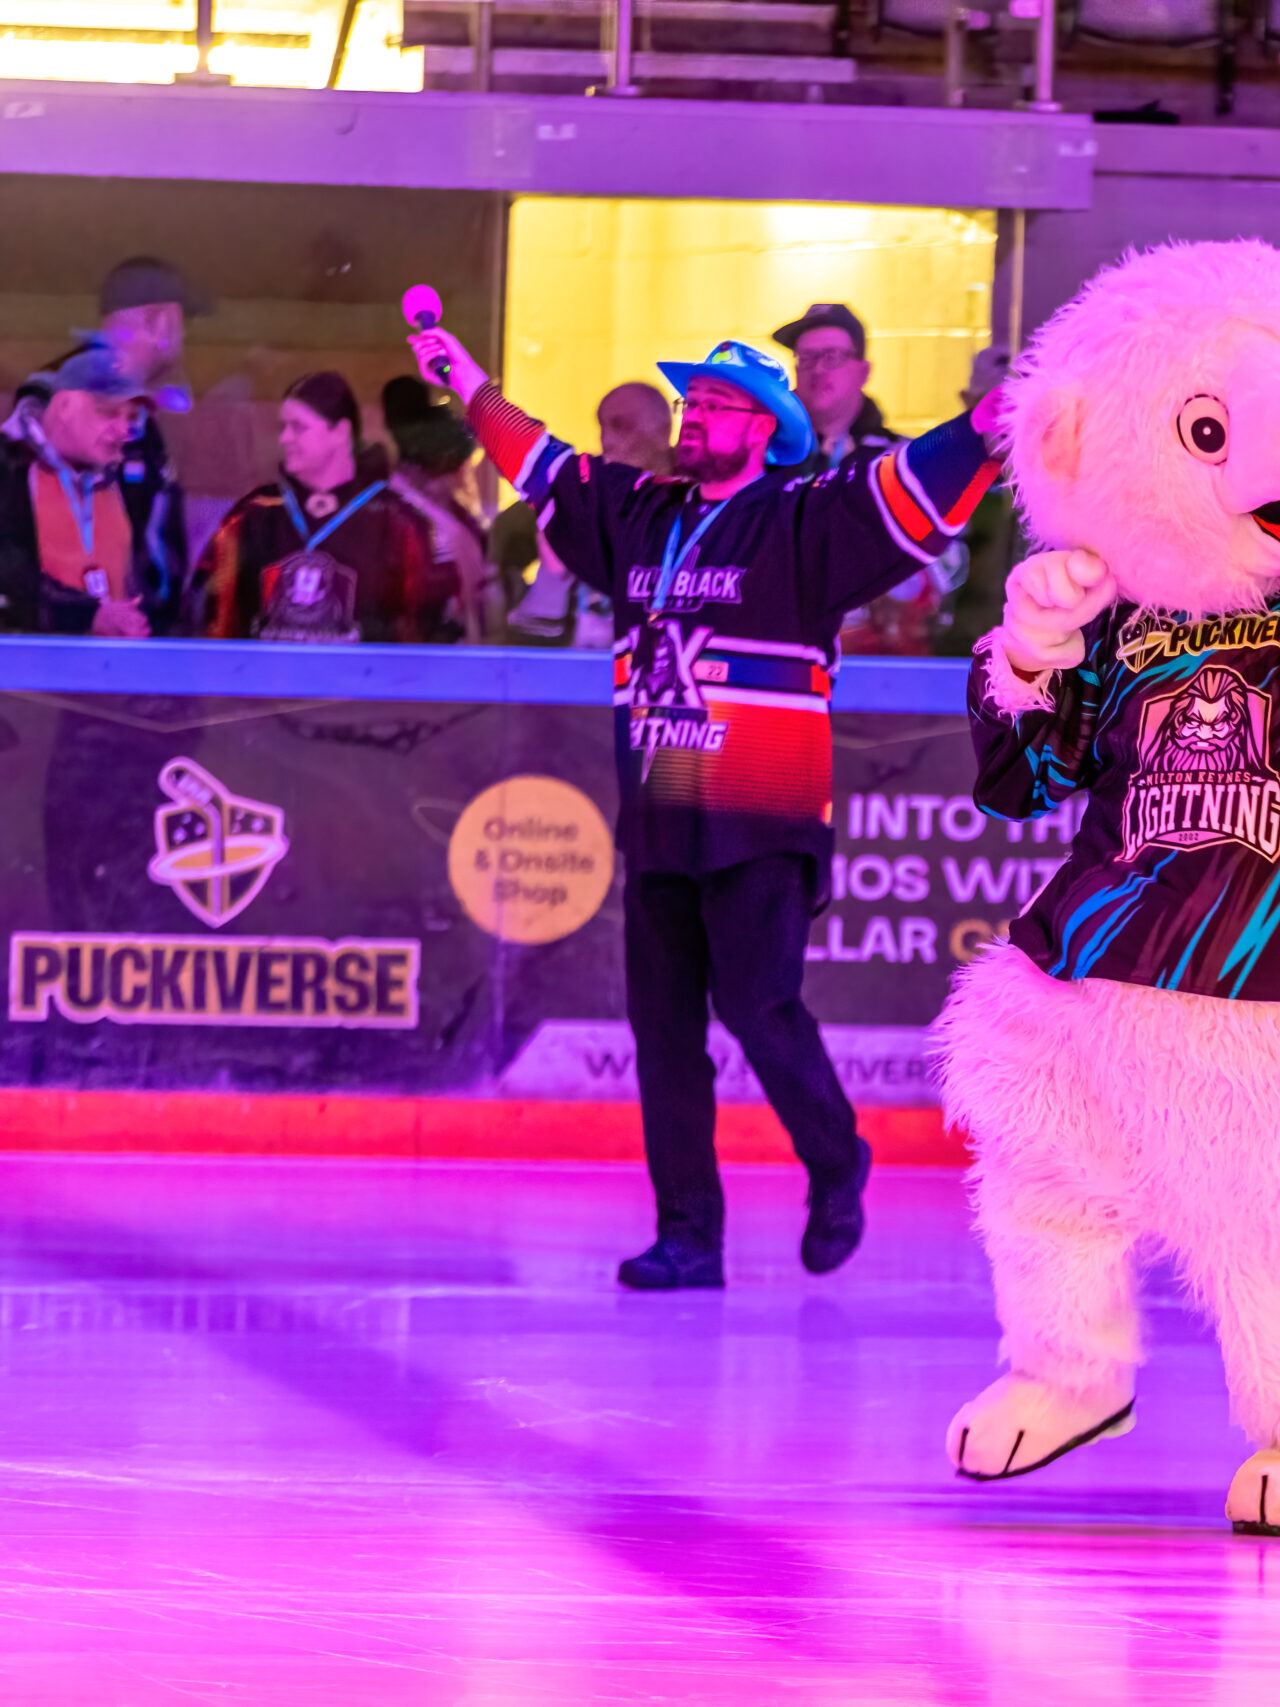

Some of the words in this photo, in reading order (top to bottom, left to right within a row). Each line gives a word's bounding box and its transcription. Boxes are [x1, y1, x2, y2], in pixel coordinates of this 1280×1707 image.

[672, 568, 740, 600] BLACK
[1146, 771, 1193, 786] MILTON
[1197, 770, 1252, 785] KEYNES
[483, 817, 579, 841] Online
[849, 793, 988, 842] INTO
[499, 849, 595, 874] Onsite
[18, 942, 411, 1018] PUCKIVERSE
